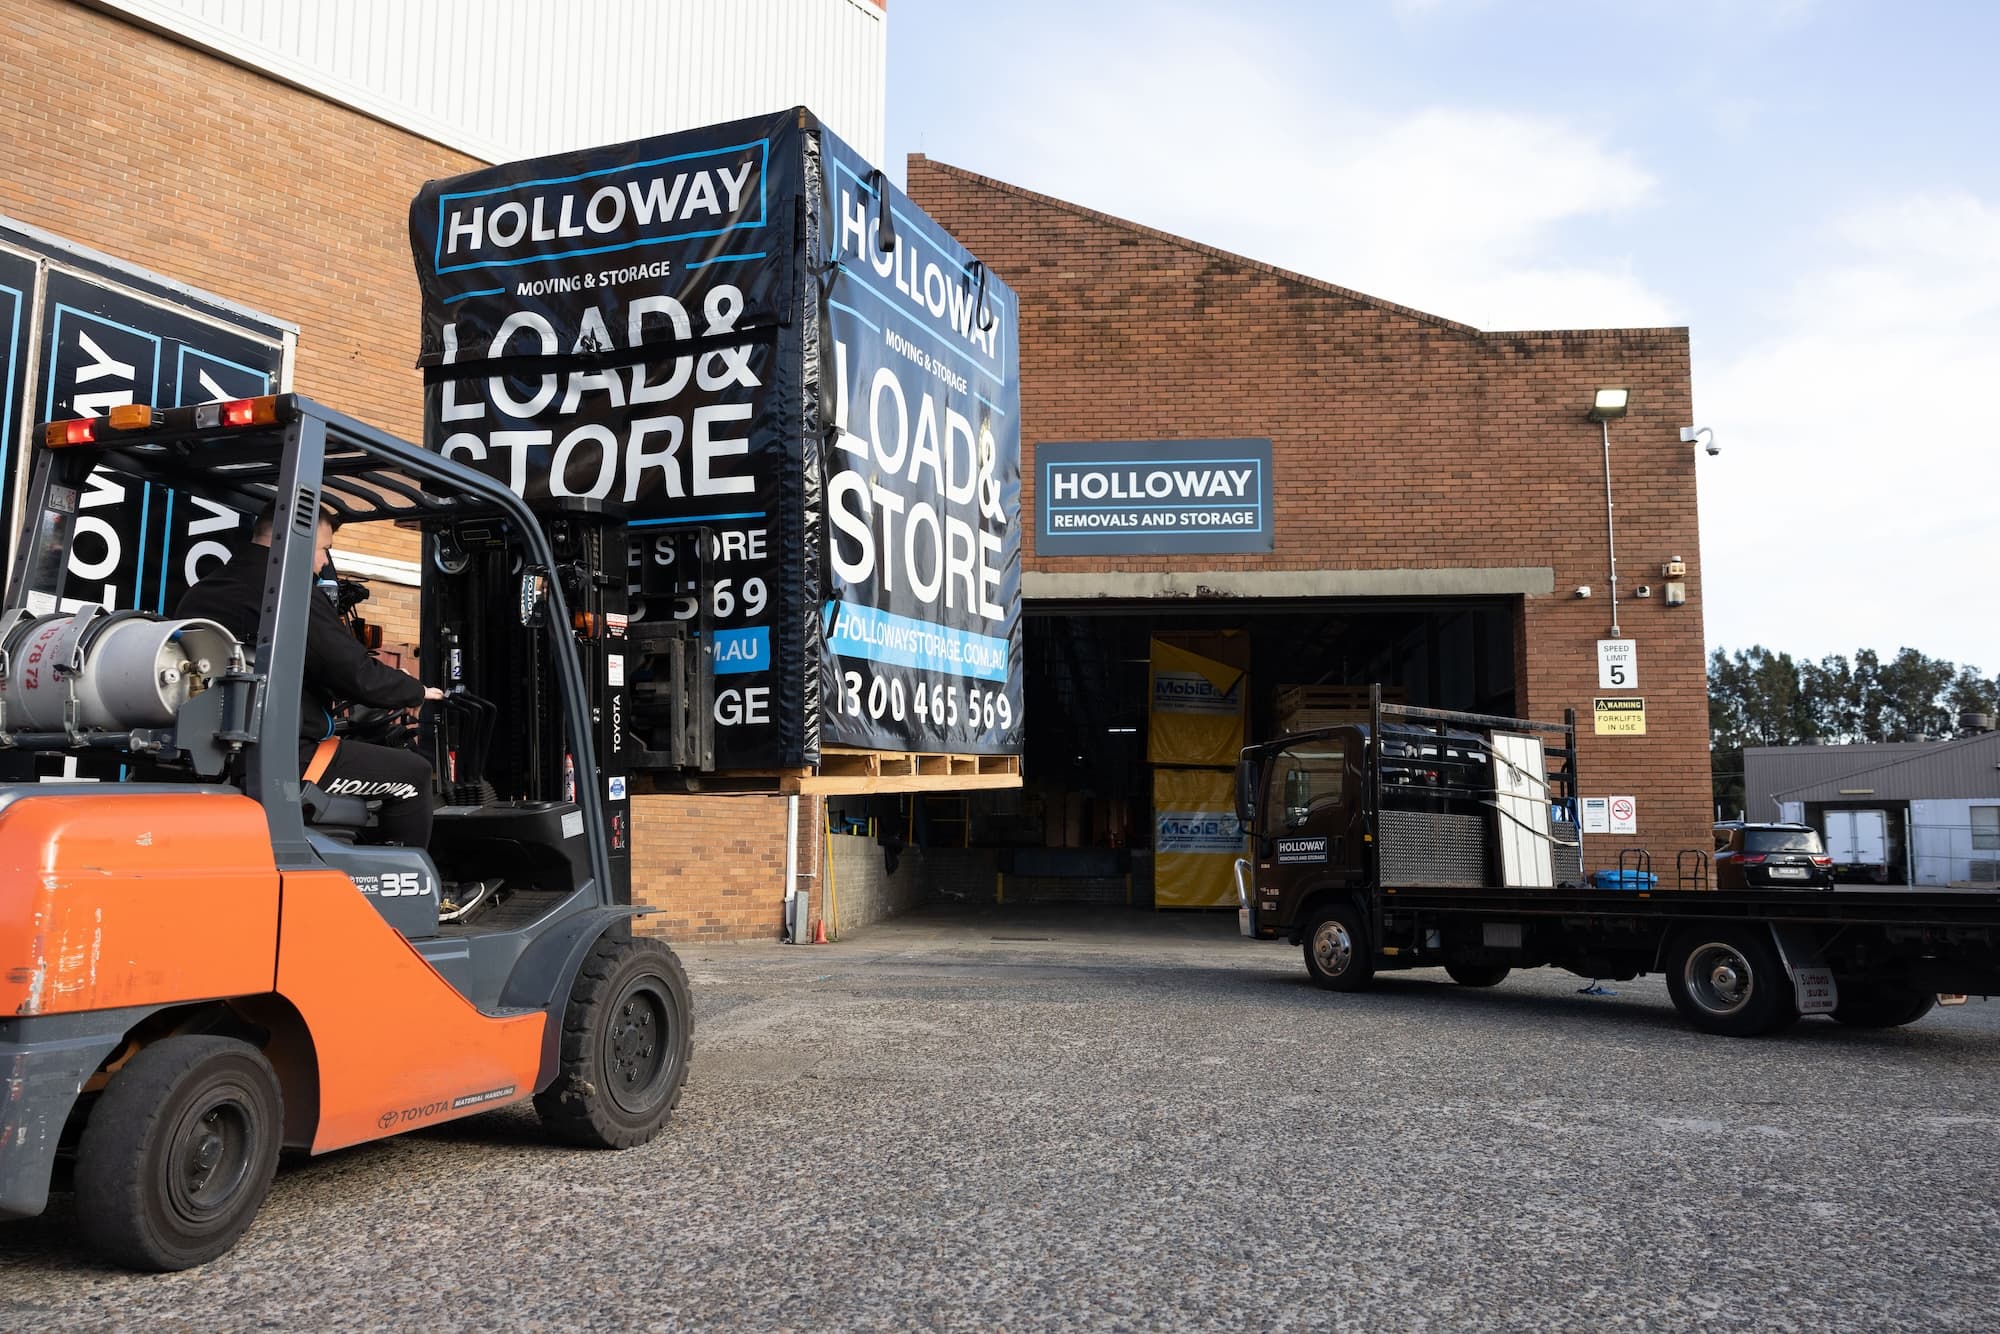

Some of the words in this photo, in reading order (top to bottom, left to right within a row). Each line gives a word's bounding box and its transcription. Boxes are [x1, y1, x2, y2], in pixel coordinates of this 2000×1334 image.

[447, 161, 754, 255] HOLLOWAY
[516, 274, 582, 297] MOVING
[584, 273, 596, 289] &
[598, 260, 671, 288] STORAGE
[842, 189, 1000, 359] HOLLOWAY
[886, 328, 923, 367] MOVING
[924, 353, 932, 371] &
[932, 359, 968, 396] STORAGE
[1054, 469, 1253, 500] HOLLOWAY
[1054, 513, 1138, 528] REMOVALS
[1141, 513, 1177, 526] AND
[1180, 512, 1254, 526] STORAGE
[828, 469, 1005, 621] STORE
[832, 613, 1006, 671] HOLLOWAYSTORAGE.COM.AU
[835, 667, 905, 722] 1300
[913, 682, 958, 727] 465
[968, 689, 1012, 730] 569
[1610, 665, 1625, 685] 5
[613, 694, 621, 754] TOYOTA
[1607, 701, 1641, 709] WARNING
[1279, 841, 1325, 853] HOLLOWAY
[400, 1101, 449, 1122] TOYOTA
[455, 1096, 484, 1107] MATERIAL
[484, 1087, 514, 1100] HANDLING
